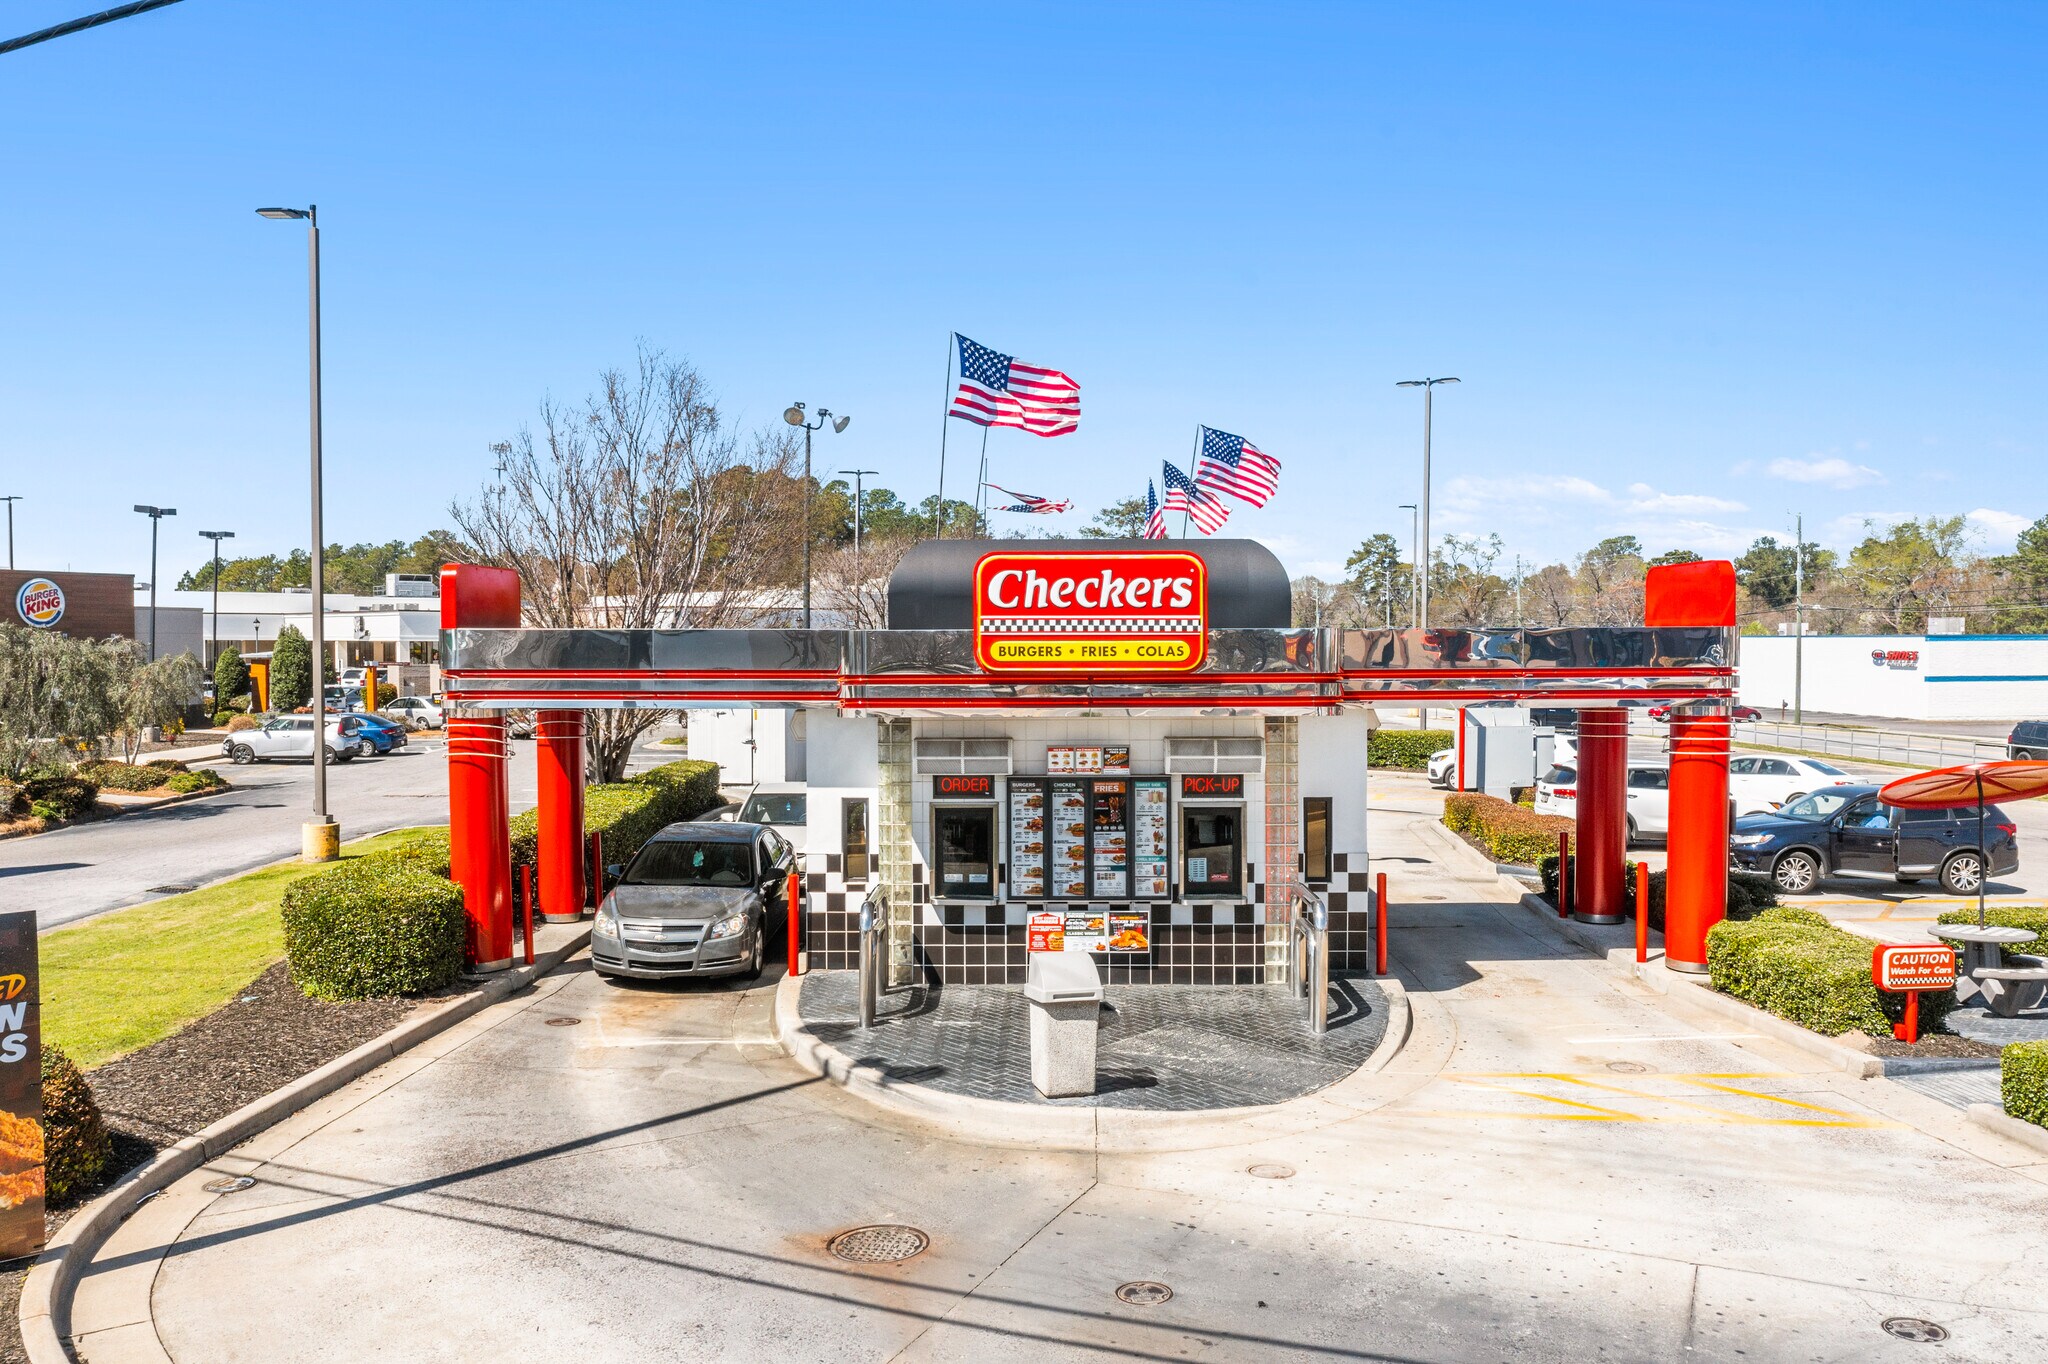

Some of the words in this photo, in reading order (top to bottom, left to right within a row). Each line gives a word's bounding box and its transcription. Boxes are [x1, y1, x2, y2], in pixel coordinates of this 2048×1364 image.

[987, 568, 1194, 609] Checkers
[25, 589, 59, 604] BURGER
[26, 597, 60, 615] KING
[998, 645, 1062, 657] BURGERS
[1081, 645, 1117, 657] FRIES
[1136, 645, 1185, 657] COLAS
[941, 777, 989, 792] ORDER
[1184, 777, 1240, 792] PICK-UP
[1892, 953, 1950, 965] CAUTION
[1890, 966, 1916, 975] Watch
[1918, 966, 1932, 975] For
[1934, 965, 1952, 974] Cars
